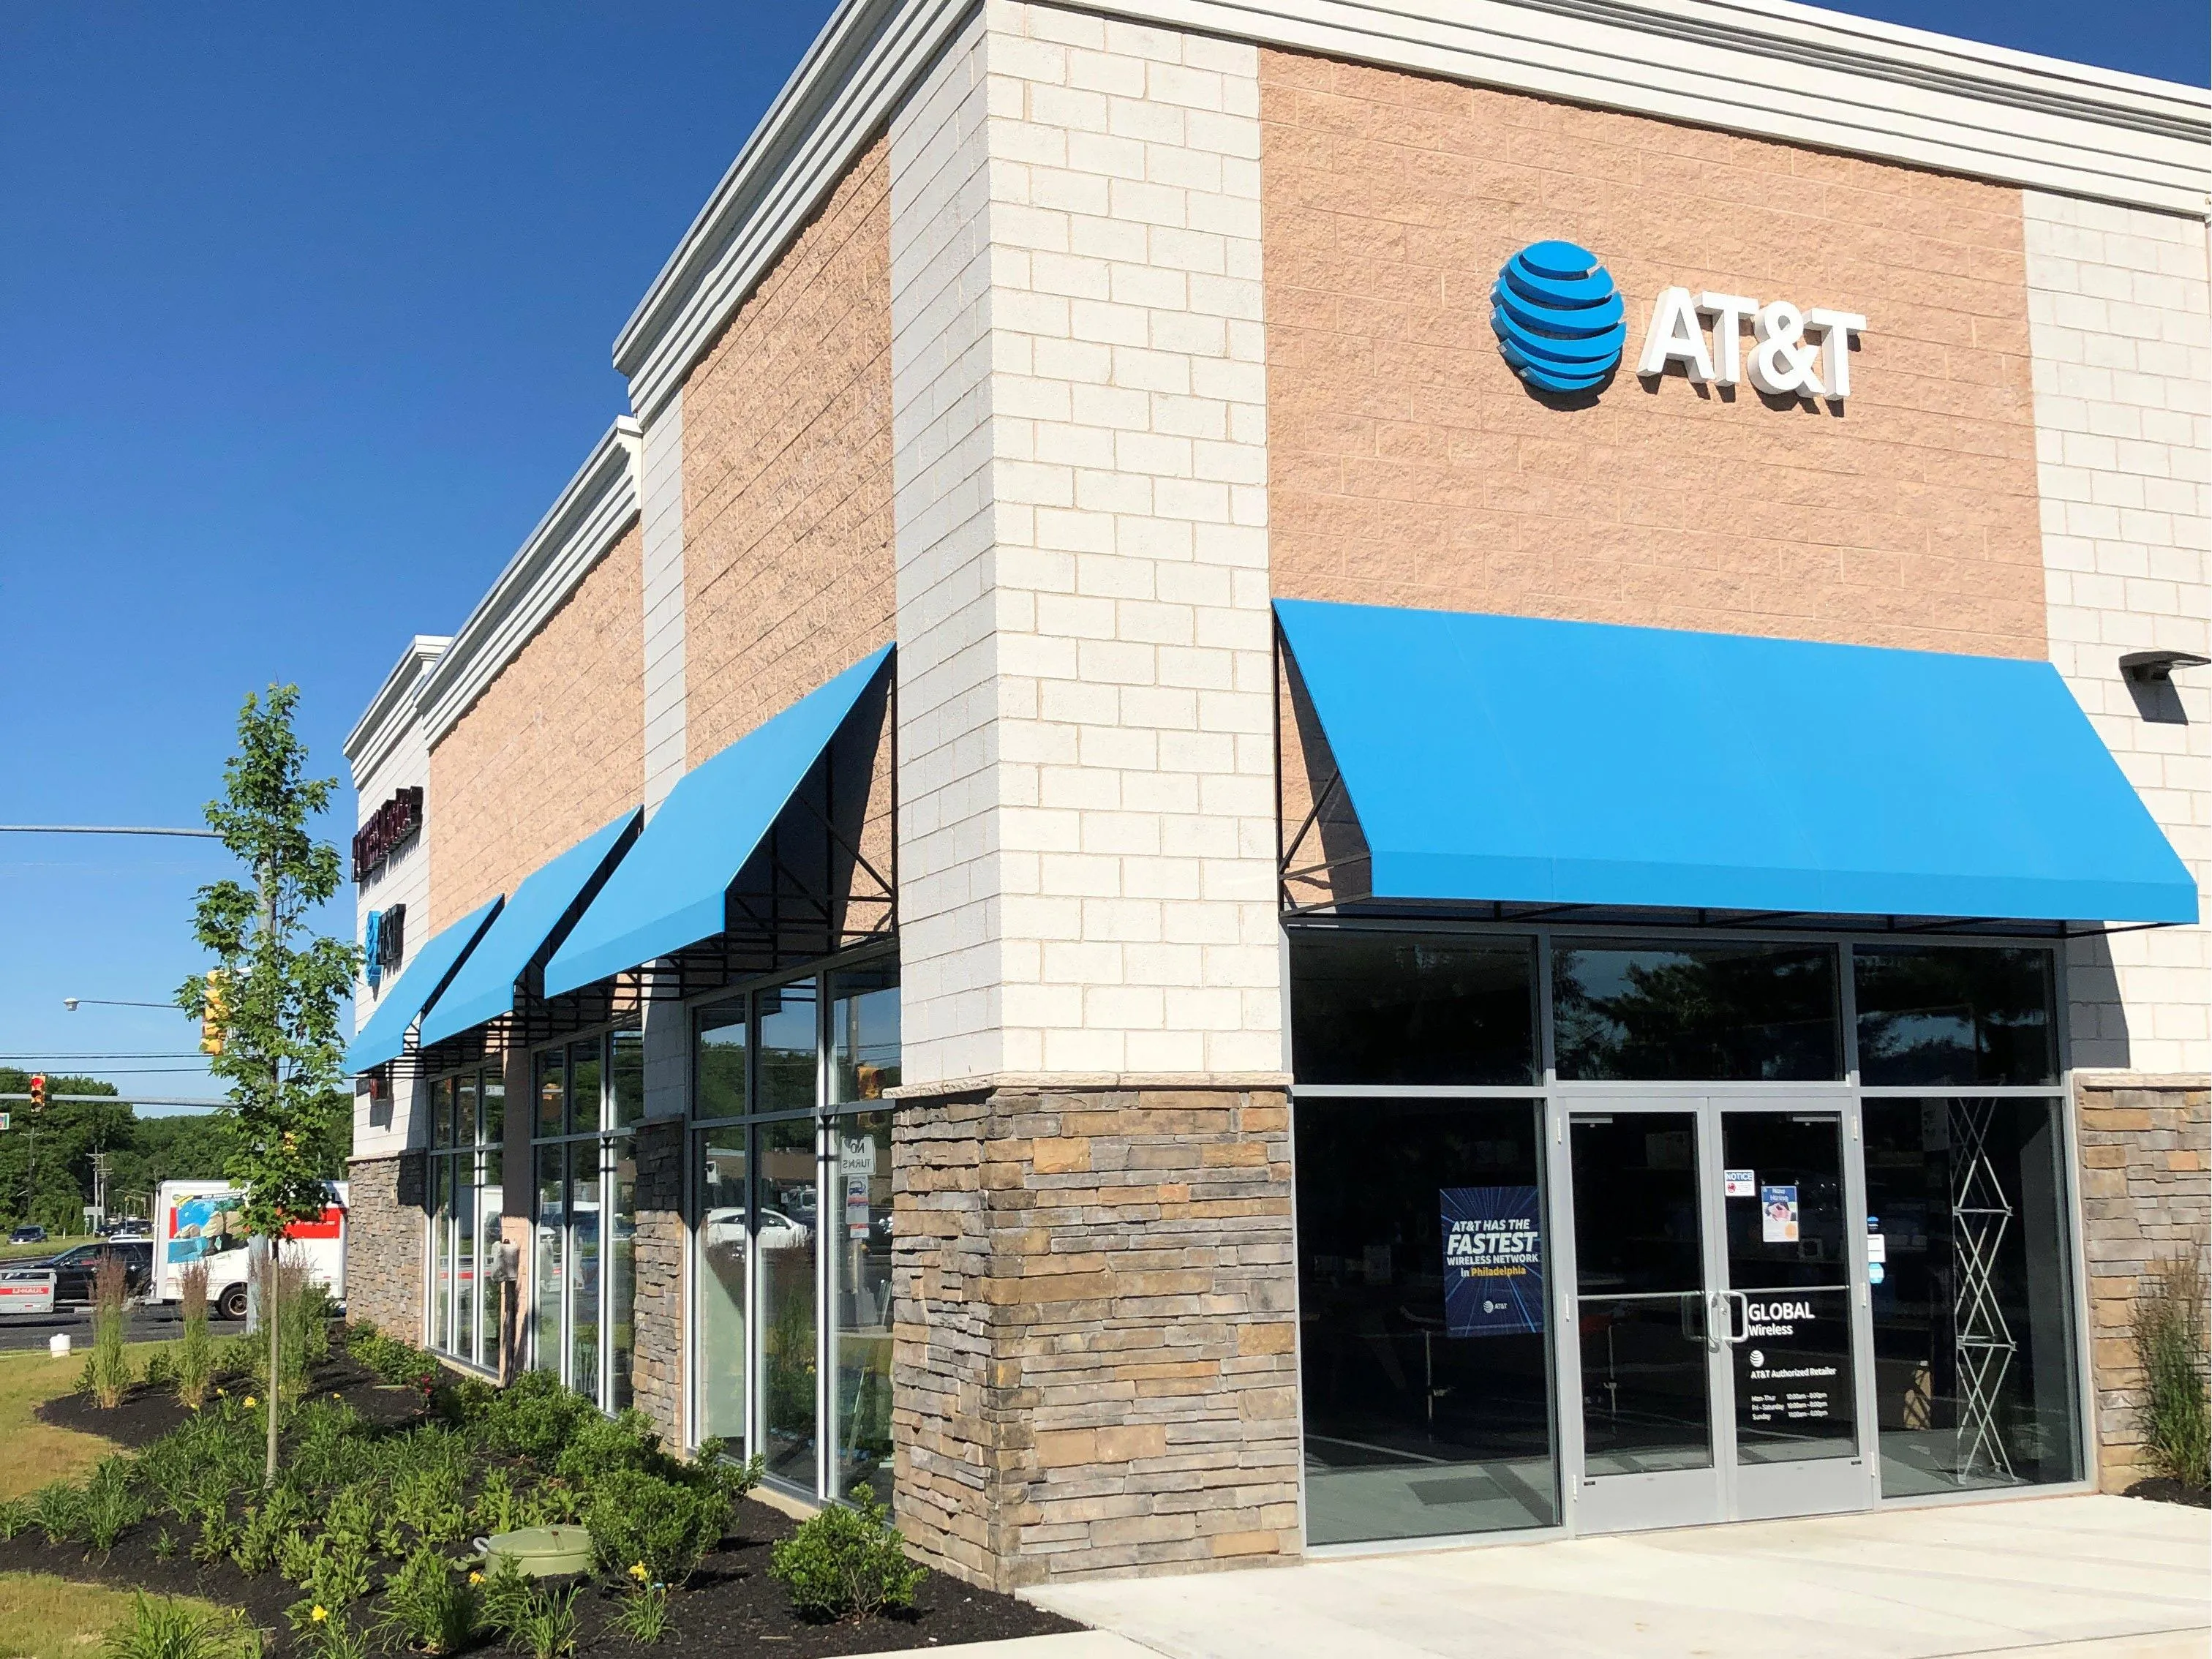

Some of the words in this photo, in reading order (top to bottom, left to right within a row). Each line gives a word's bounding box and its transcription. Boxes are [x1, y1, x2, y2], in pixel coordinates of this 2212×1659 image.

[1636, 286, 1867, 401] AT&T
[1726, 1173, 1753, 1181] NOTICE
[1451, 1220, 1482, 1233] AT&T
[1483, 1219, 1507, 1231] HAS
[1508, 1219, 1530, 1230] THE
[1447, 1232, 1538, 1255] FASTEST
[1447, 1255, 1492, 1266] WIRELESS
[1493, 1253, 1539, 1264] NETWORK
[1471, 1265, 1527, 1277] Philadelphia
[1748, 1301, 1816, 1321] GLOBAL
[1748, 1323, 1794, 1336] Wireless
[1750, 1369, 1770, 1380] AT&T
[1771, 1368, 1810, 1378] Authorized
[1810, 1366, 1837, 1376] Retailer
